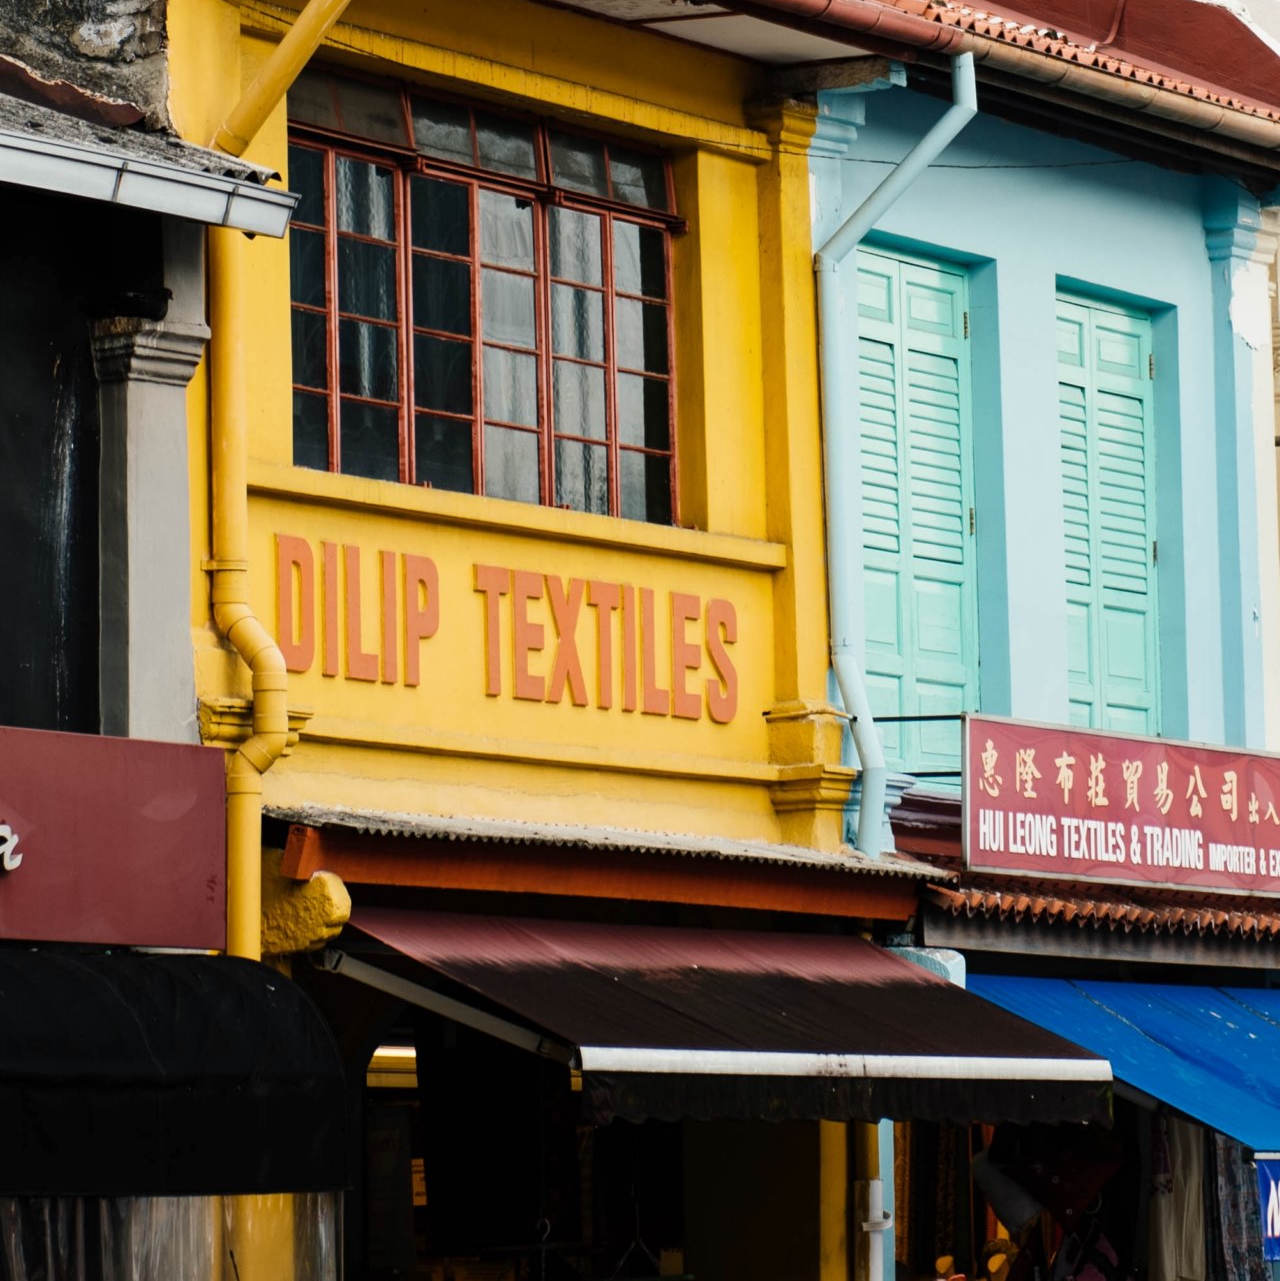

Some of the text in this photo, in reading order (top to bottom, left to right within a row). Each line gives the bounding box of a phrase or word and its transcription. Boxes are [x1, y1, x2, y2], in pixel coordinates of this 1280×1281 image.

[274, 533, 738, 724] DILIP TEXTILES
[979, 809, 1004, 852] HUI
[1008, 812, 1057, 857] LEONG
[1061, 817, 1126, 864] TEXTILES
[1130, 825, 1142, 865] &
[1144, 825, 1204, 870] TRADING
[1208, 843, 1256, 876] IMPORTER
[1259, 848, 1267, 876] &
